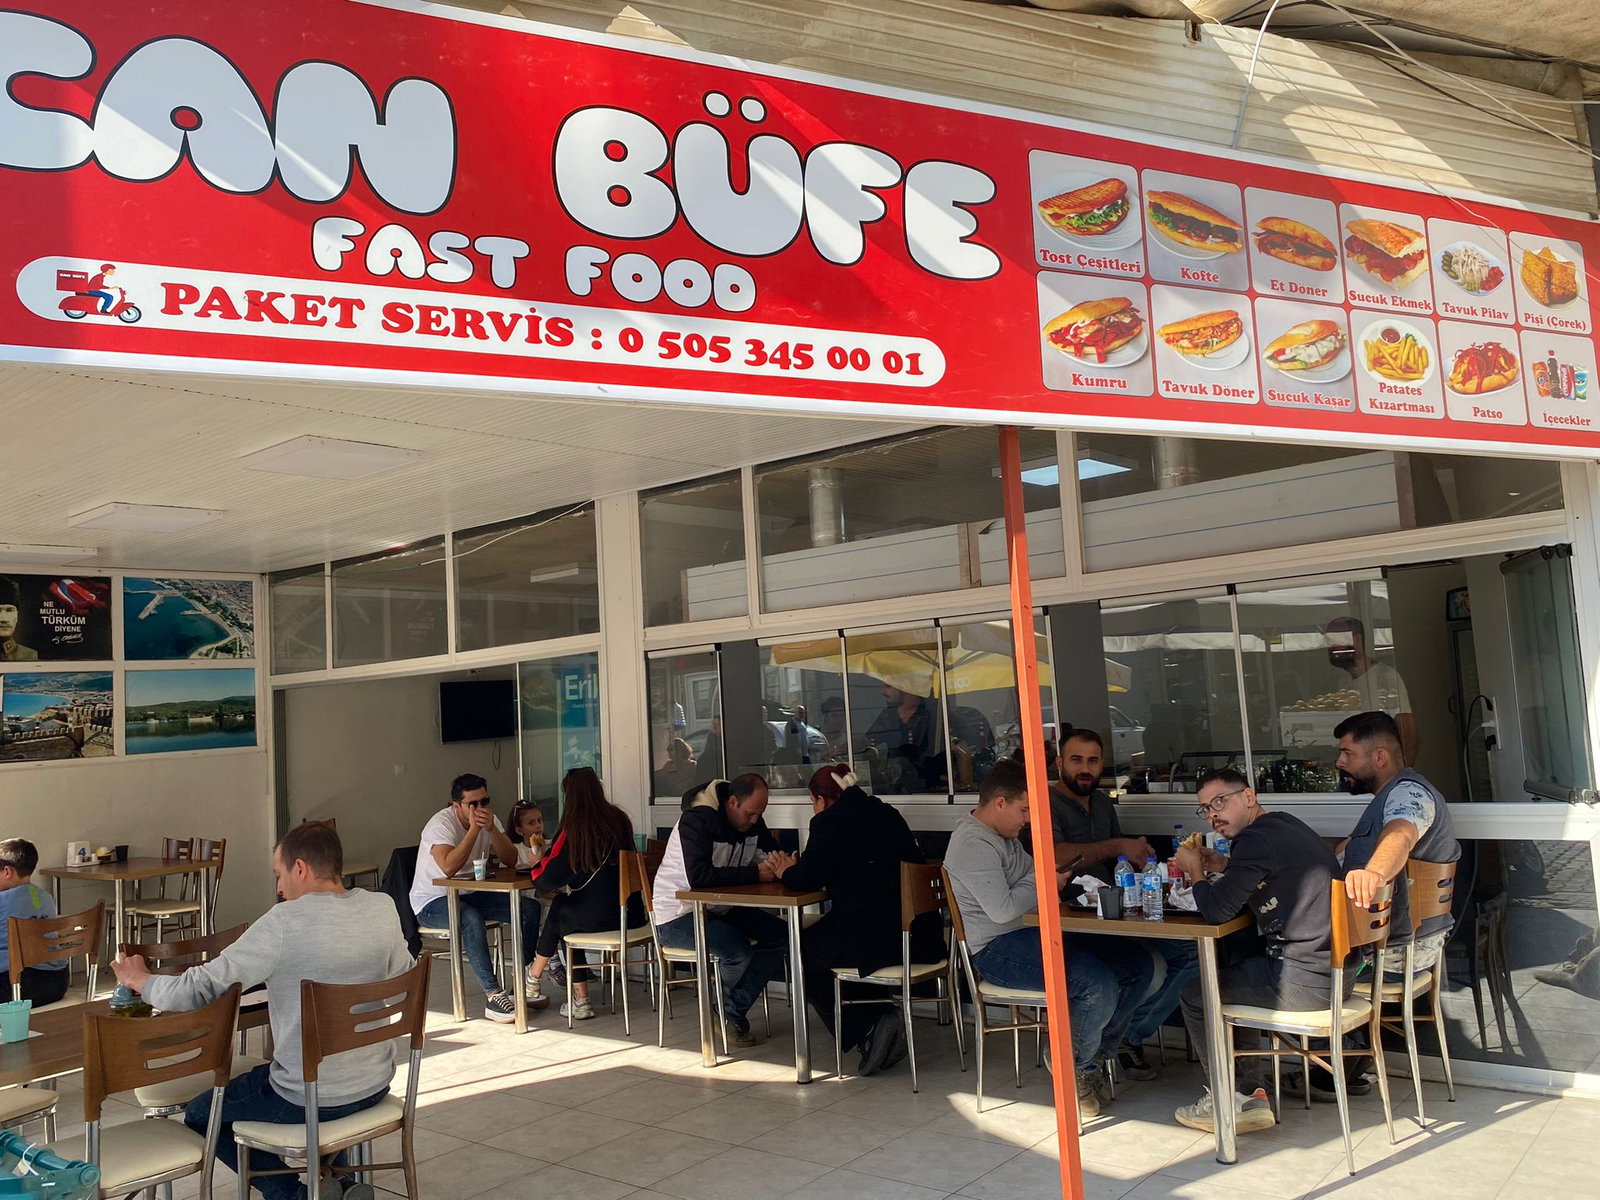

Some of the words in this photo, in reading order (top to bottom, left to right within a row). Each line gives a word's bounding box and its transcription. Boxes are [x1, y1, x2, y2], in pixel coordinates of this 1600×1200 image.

[0, 9, 457, 217] CAN
[553, 90, 1002, 281] BÜFE
[312, 216, 530, 289] FAST
[565, 244, 757, 312] FOOD
[1039, 249, 1073, 265] Tost
[1076, 254, 1142, 273] Çeşitleri
[1270, 279, 1286, 292] Et
[1349, 290, 1388, 305] Sucuk
[1391, 295, 1432, 310] Ekmek
[1442, 302, 1479, 317] Tavuk
[1481, 306, 1509, 320] Pilav
[1523, 312, 1544, 327] Pişi
[160, 281, 364, 329] PAKET
[381, 302, 574, 348] SERVİS
[618, 327, 644, 353] 0
[658, 331, 732, 363] 505
[744, 338, 815, 370] 345
[827, 346, 871, 371] 00
[882, 350, 924, 375] 01
[1071, 373, 1128, 389] Kumru
[1162, 380, 1209, 396] Tavuk
[1211, 383, 1256, 399] Döner
[1378, 382, 1423, 397] Patates
[1267, 389, 1311, 404] Sucuk
[1313, 393, 1351, 408] Kaşar
[1368, 397, 1436, 414] Kızartması
[1472, 406, 1503, 419] Patso
[1542, 411, 1592, 427] İçecekler
[41, 614, 86, 625] TÜRKÜM
